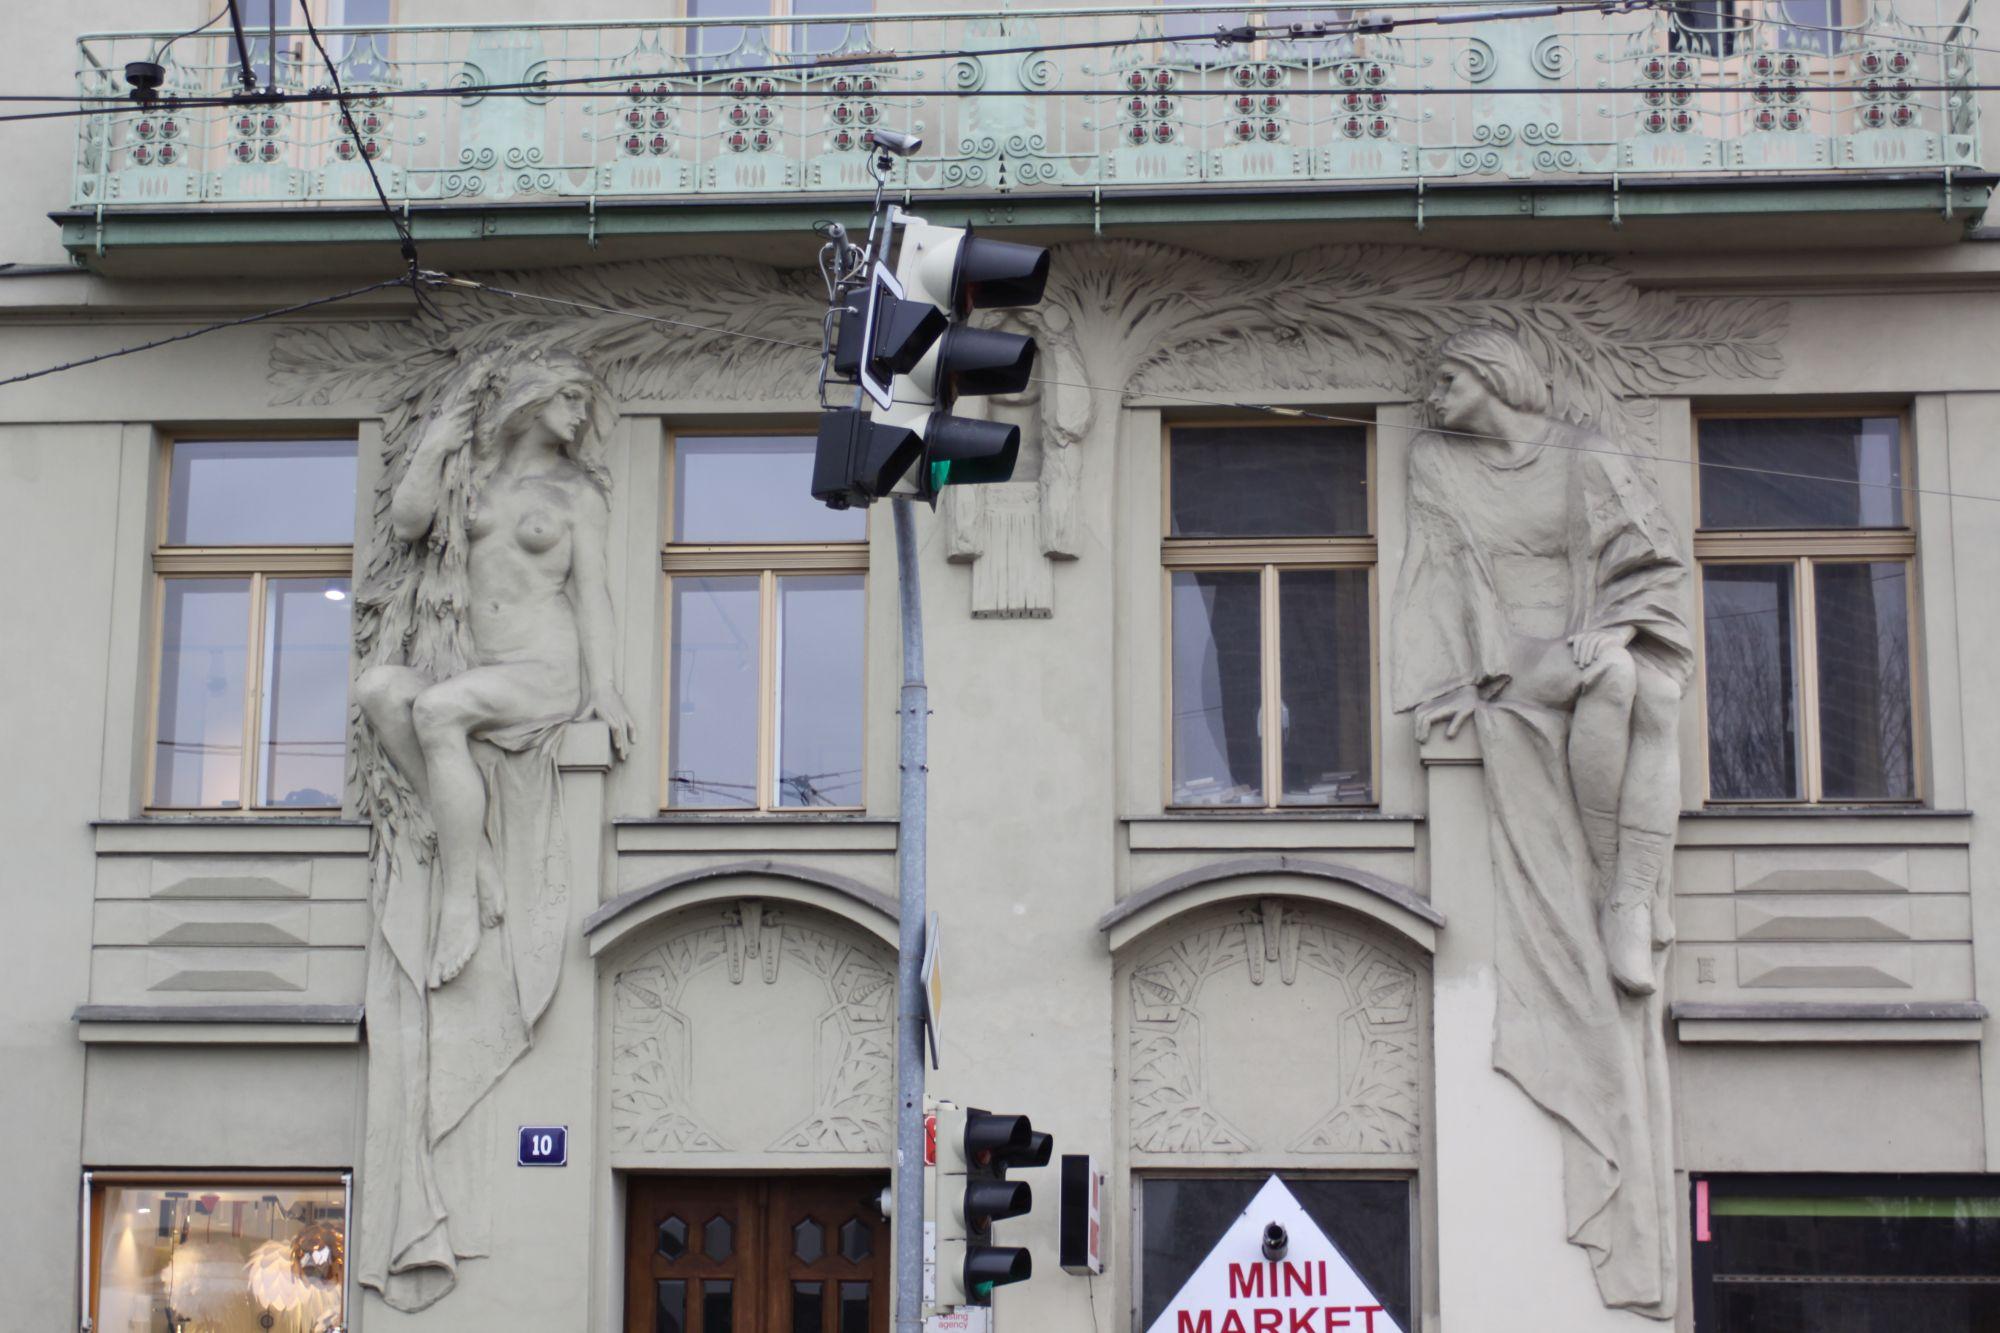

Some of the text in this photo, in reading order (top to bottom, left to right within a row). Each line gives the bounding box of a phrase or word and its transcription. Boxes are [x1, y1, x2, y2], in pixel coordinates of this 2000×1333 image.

[532, 1134, 552, 1156] 10
[1229, 1261, 1327, 1298] MINI
[939, 1321, 968, 1329] agency
[1177, 1306, 1385, 1333] MARKET
